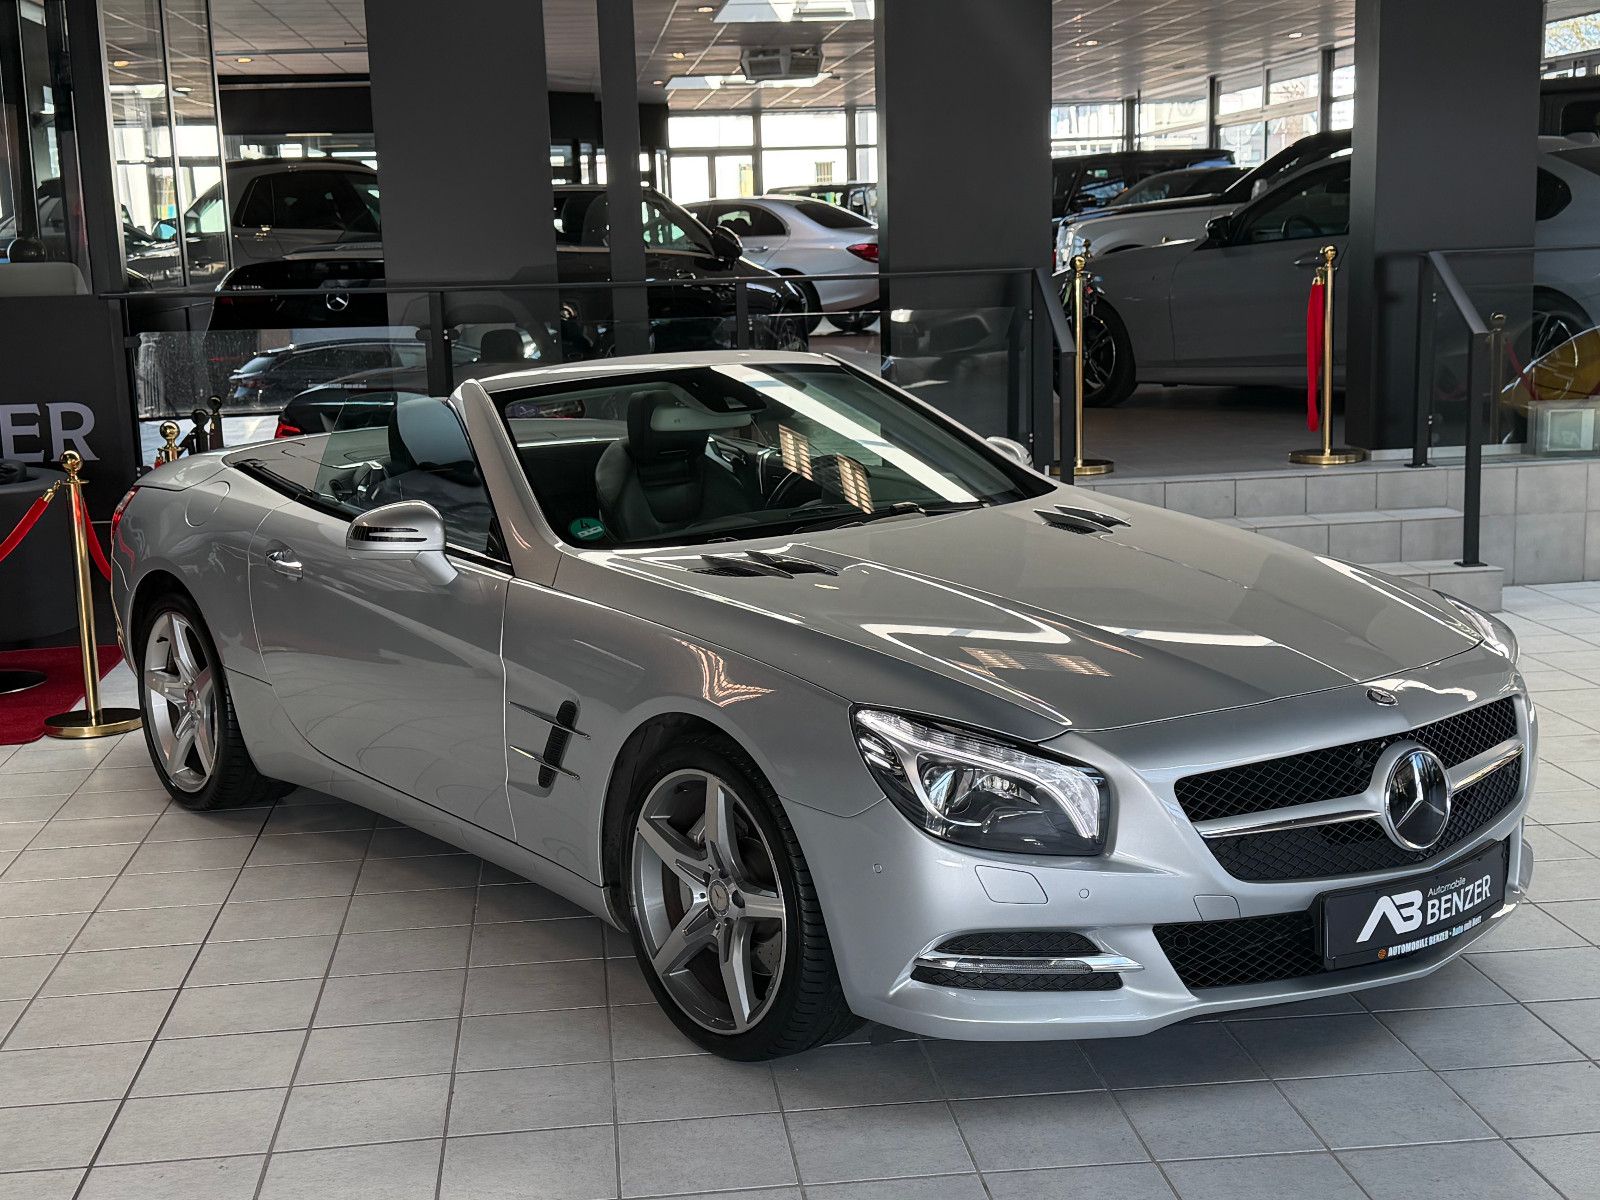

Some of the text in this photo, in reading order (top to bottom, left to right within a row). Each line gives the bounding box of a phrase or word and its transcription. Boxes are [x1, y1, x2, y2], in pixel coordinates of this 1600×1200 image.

[1427, 877, 1467, 897] Automobile
[1426, 874, 1491, 925] BENZER
[1388, 937, 1428, 957] AUTOMOBILE
